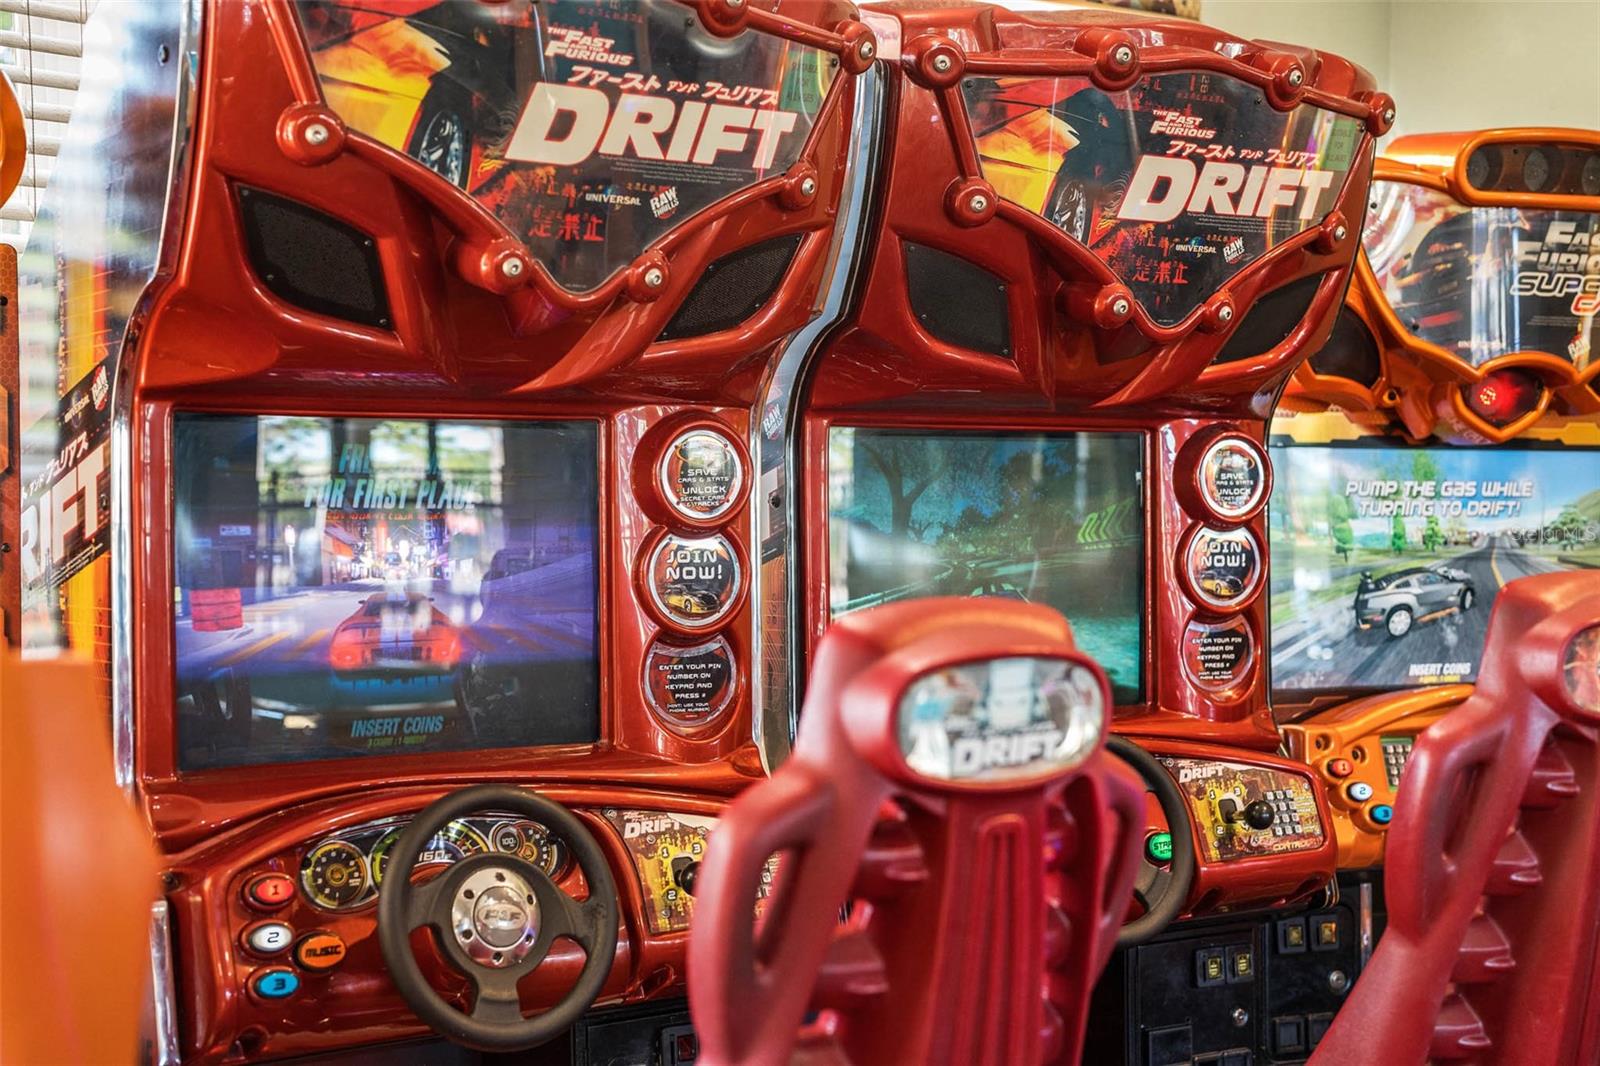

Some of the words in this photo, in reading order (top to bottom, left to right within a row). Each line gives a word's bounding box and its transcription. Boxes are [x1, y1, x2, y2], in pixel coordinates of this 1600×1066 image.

[547, 26, 567, 35] THE
[564, 30, 615, 49] FAST
[544, 40, 634, 66] FURIOUS
[567, 65, 662, 91] ファースト
[666, 80, 700, 95] アンド
[701, 81, 779, 105] フュリアス
[504, 82, 798, 169] DRIFT
[1165, 111, 1203, 126] FAST
[1150, 120, 1217, 139] FURIOUS
[1166, 140, 1236, 159] ファースト
[1264, 148, 1321, 167] フュリアス
[1117, 154, 1335, 223] DRIFT
[585, 193, 642, 206] UNIVERSAL
[650, 187, 678, 209] RAW
[1175, 244, 1217, 254] UNIVERSAL
[1223, 236, 1244, 256] RAW
[687, 468, 718, 477] SAVE
[1220, 472, 1245, 480] SAVE
[304, 478, 347, 509] FOR
[352, 478, 414, 509] FIRST
[682, 485, 727, 494] UNLOCK
[1345, 480, 1399, 498] PUMP
[1403, 480, 1436, 498] THE
[1481, 480, 1534, 498] WHILE
[1440, 501, 1463, 516] TO
[1466, 501, 1521, 517] DRIFT!
[1200, 541, 1242, 553] JOIN
[666, 550, 718, 564] JOIN
[1200, 553, 1247, 567] NOW!
[665, 565, 723, 580] NOW!
[667, 672, 699, 680] NUMBER
[1408, 663, 1443, 677] INSERT
[1442, 662, 1472, 676] COINS
[665, 682, 695, 690] KEYPAD
[696, 682, 713, 690] AND
[351, 717, 401, 738] INSERT
[402, 715, 445, 734] COINS
[1179, 765, 1225, 783] DRIFT
[624, 818, 680, 839] DRIFT
[662, 848, 669, 857] 1
[692, 843, 701, 853] 3
[419, 850, 445, 862] 160
[667, 890, 677, 900] 2
[267, 931, 280, 944] 2
[272, 978, 286, 991] 3
